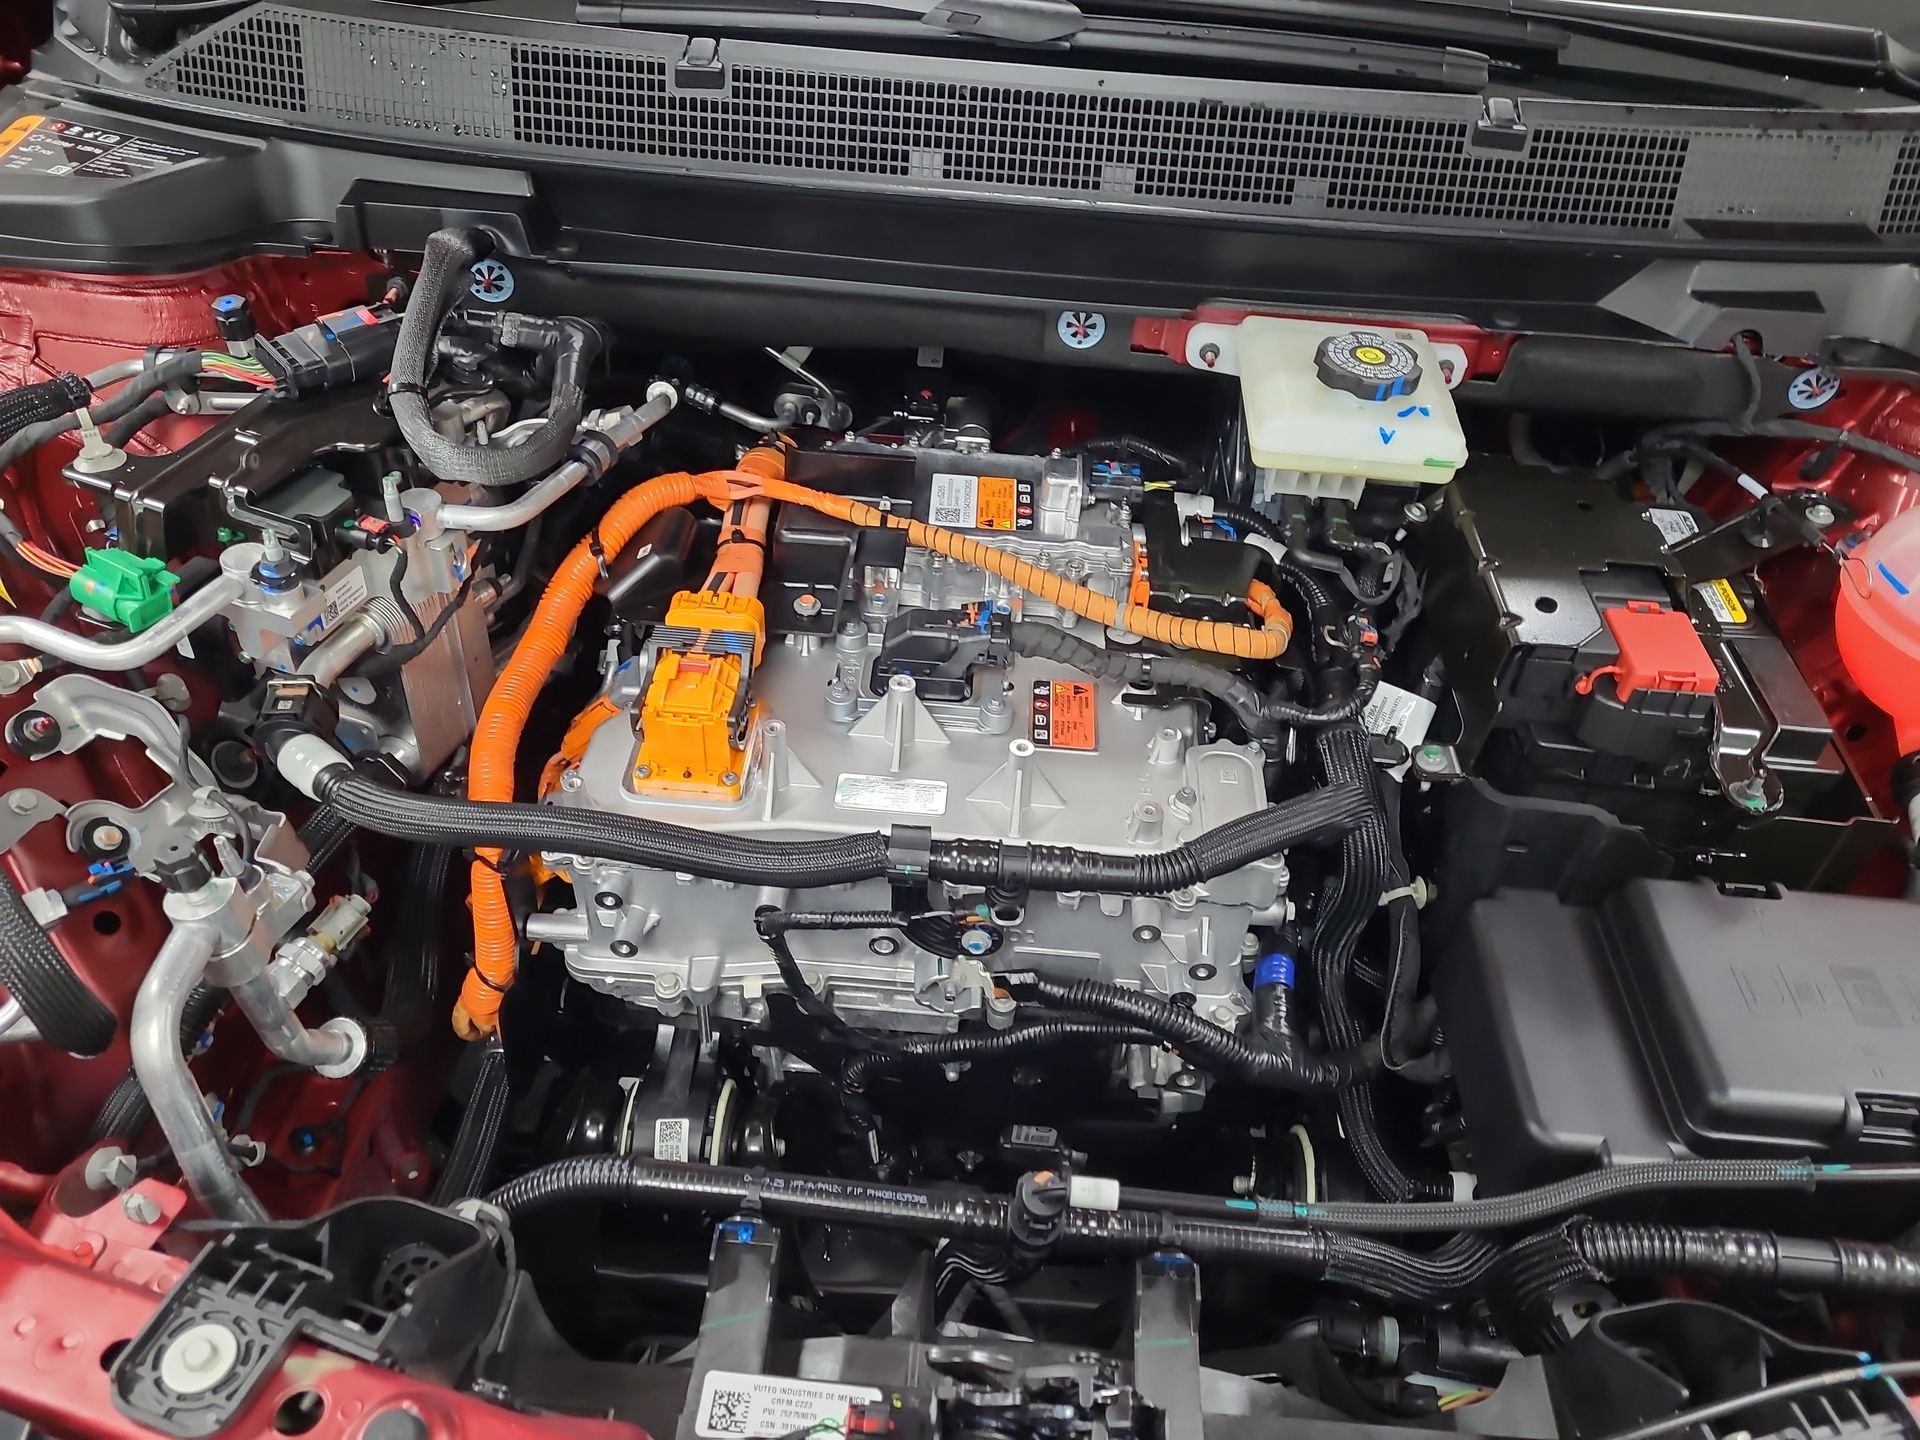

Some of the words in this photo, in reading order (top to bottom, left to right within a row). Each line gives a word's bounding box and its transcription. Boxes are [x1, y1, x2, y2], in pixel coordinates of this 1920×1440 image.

[753, 1384, 777, 1394] VUTEQ
[779, 1387, 824, 1399] INDUSTRIES
[825, 1392, 835, 1400] DE
[771, 1397, 793, 1407] CRFM
[795, 1400, 813, 1409] C223
[760, 1420, 776, 1429] CSN
